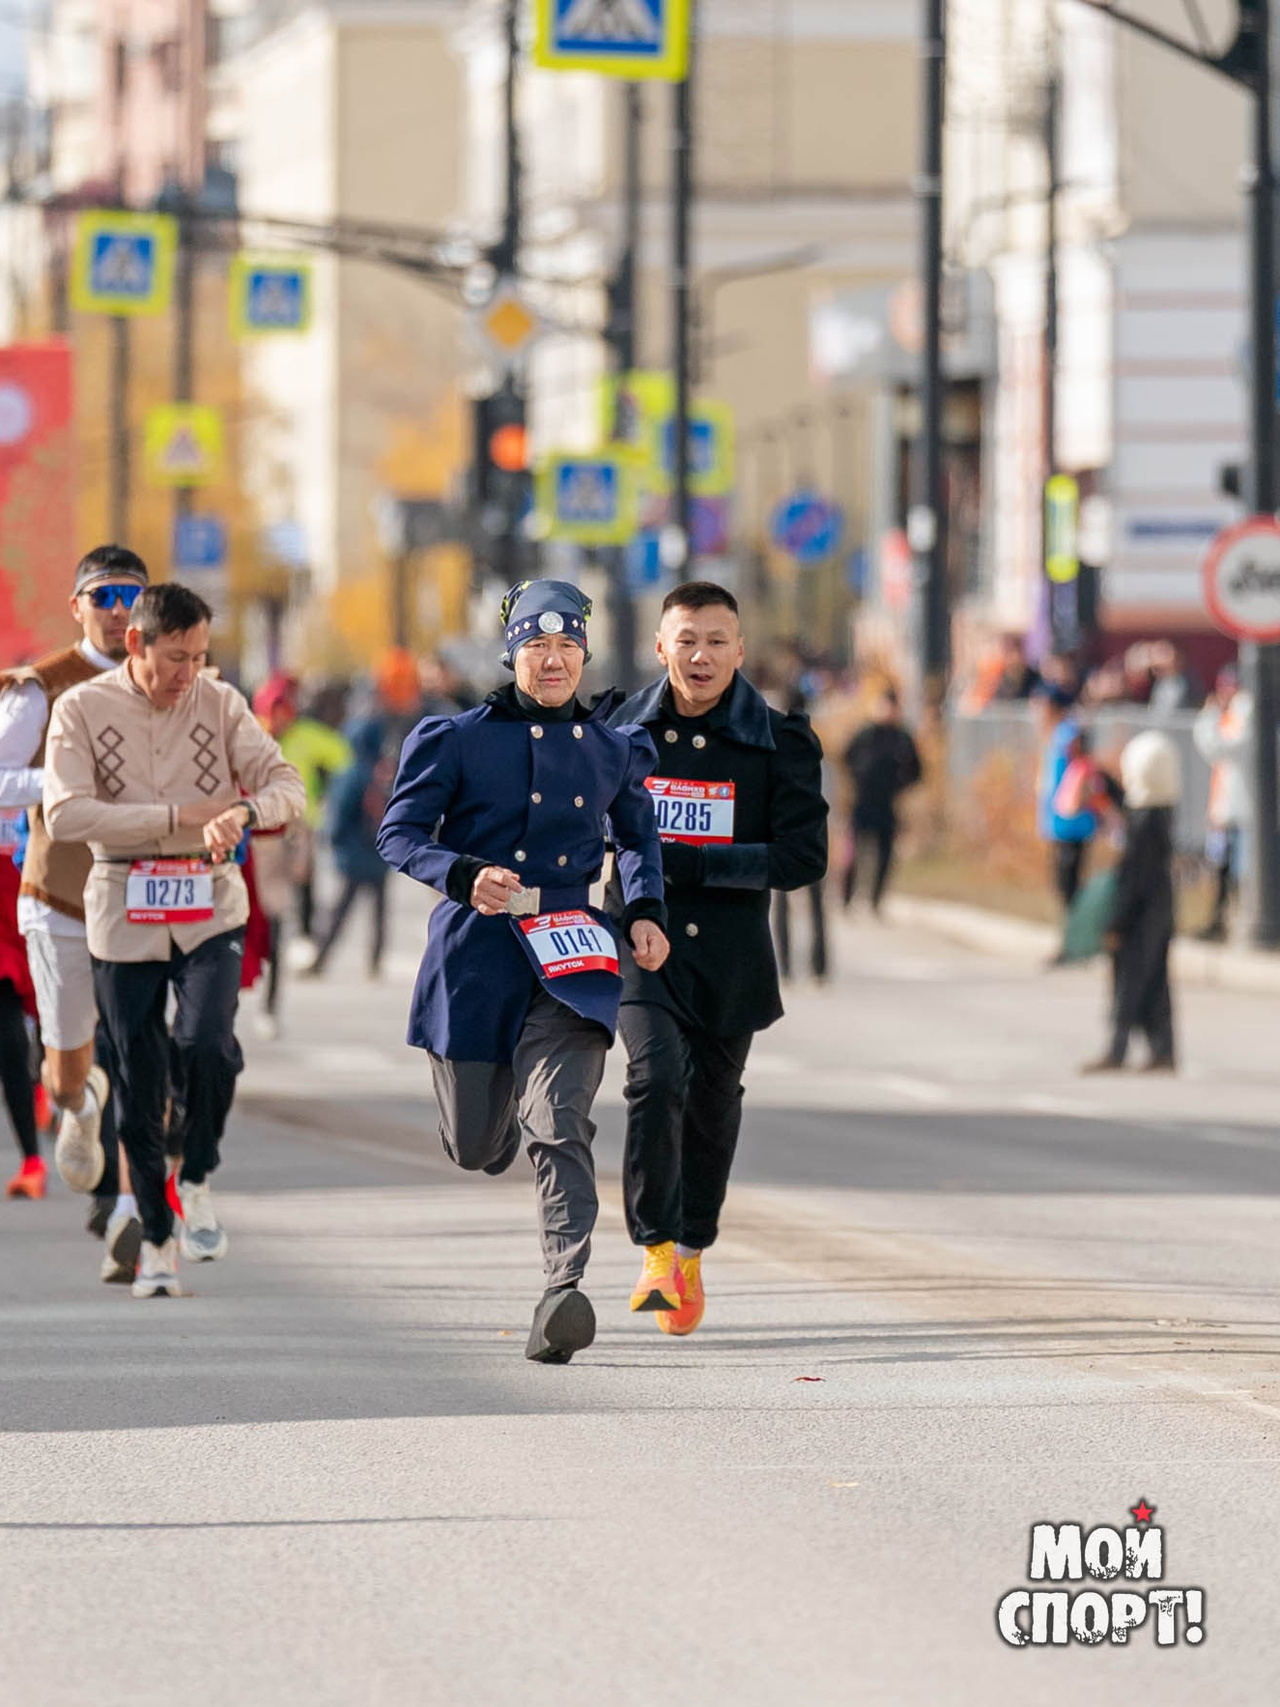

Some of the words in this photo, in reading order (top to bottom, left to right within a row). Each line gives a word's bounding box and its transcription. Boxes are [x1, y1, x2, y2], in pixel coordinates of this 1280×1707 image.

[657, 799, 712, 832] 0285
[146, 879, 195, 906] 0273
[549, 927, 603, 956] 0141
[547, 960, 585, 974] ЯКУТСК
